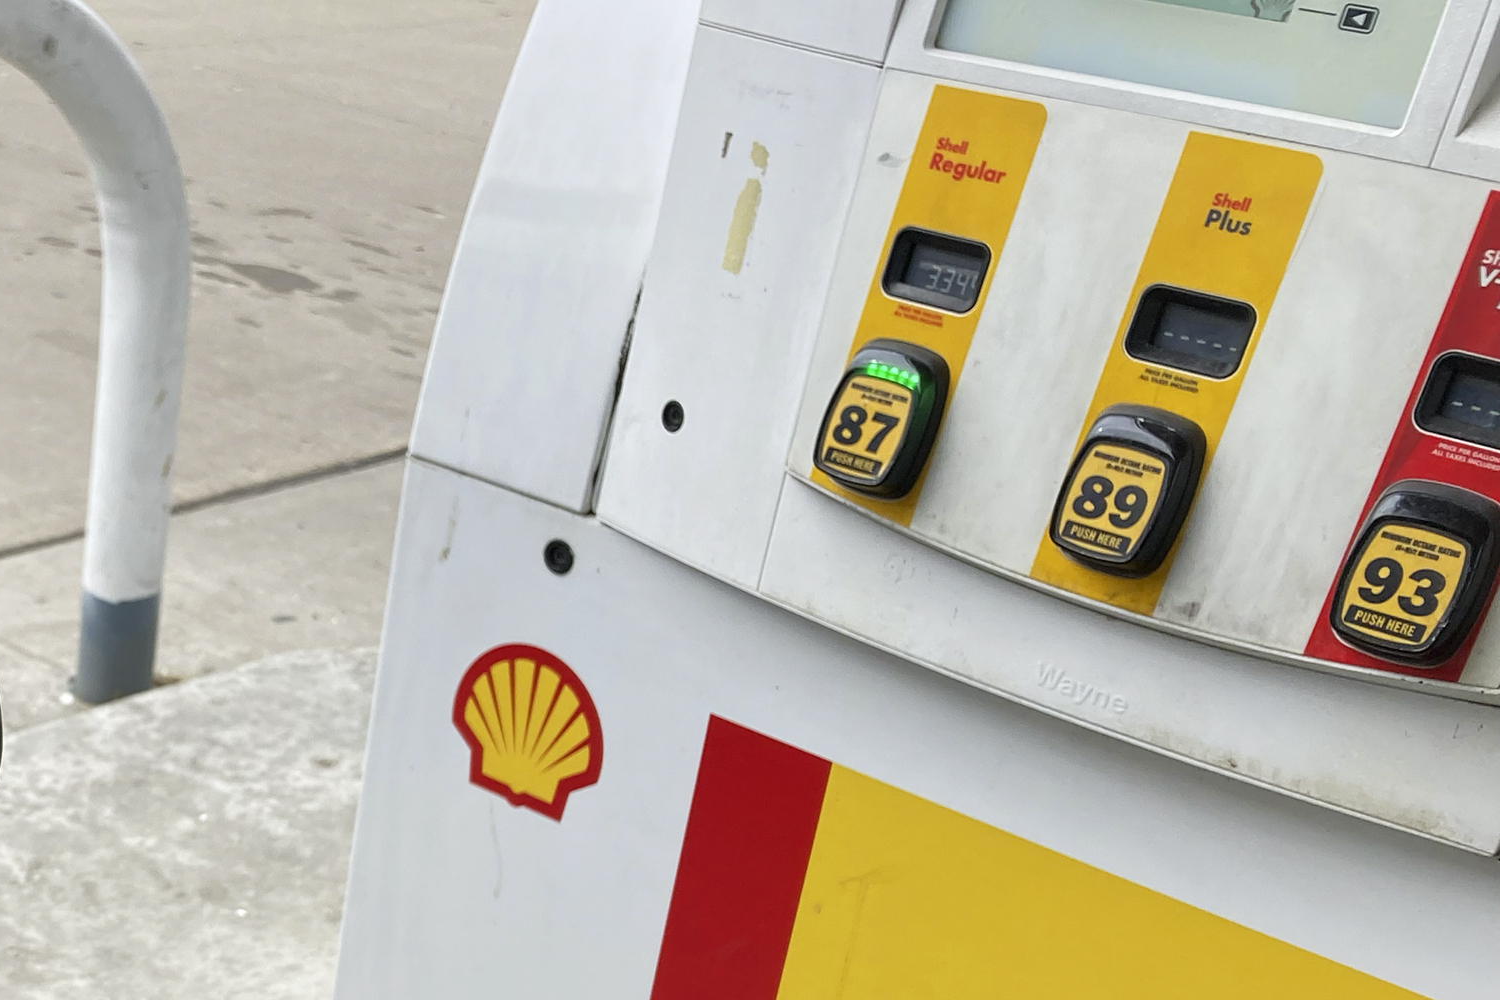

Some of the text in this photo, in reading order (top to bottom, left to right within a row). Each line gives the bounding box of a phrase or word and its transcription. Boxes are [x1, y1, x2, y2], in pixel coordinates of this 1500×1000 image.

[936, 137, 969, 155] Shell
[929, 151, 1007, 184] Regular
[1212, 192, 1252, 212] Shell
[1204, 208, 1252, 236] Plus
[832, 405, 901, 454] 87
[1072, 475, 1148, 529] 89
[1070, 526, 1123, 550] PUSH HERE
[1357, 557, 1446, 617] 93
[1354, 609, 1417, 637] PUSH HERE
[1037, 660, 1128, 715] Wayne
